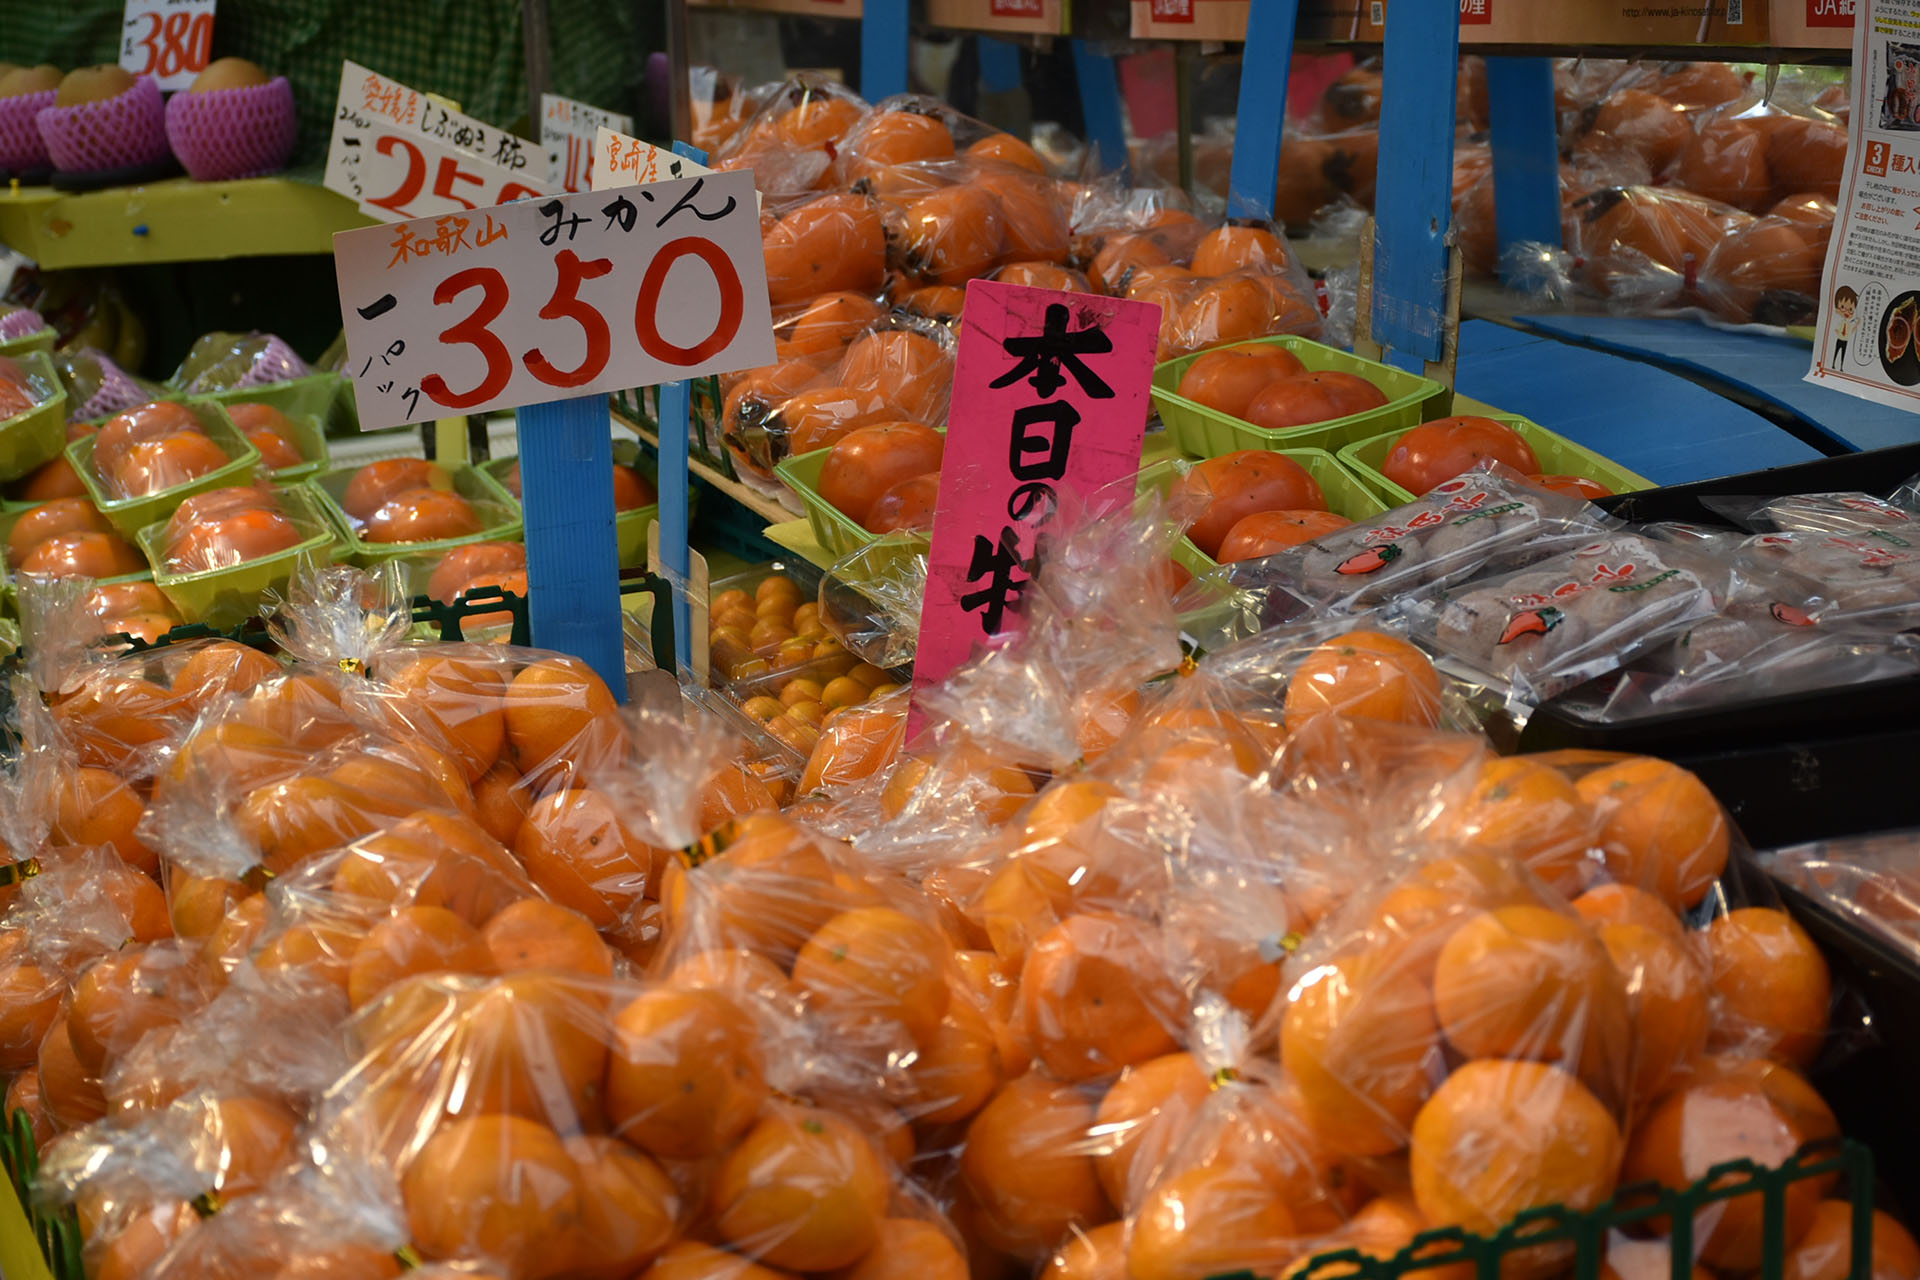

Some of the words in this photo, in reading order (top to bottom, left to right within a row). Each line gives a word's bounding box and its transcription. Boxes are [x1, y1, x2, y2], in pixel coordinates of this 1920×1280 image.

[131, 12, 214, 78] 380
[1872, 143, 1883, 165] 3
[1891, 153, 1920, 175] 種入
[387, 213, 508, 270] 和歌山
[539, 178, 737, 246] みかん
[420, 236, 744, 409] 350
